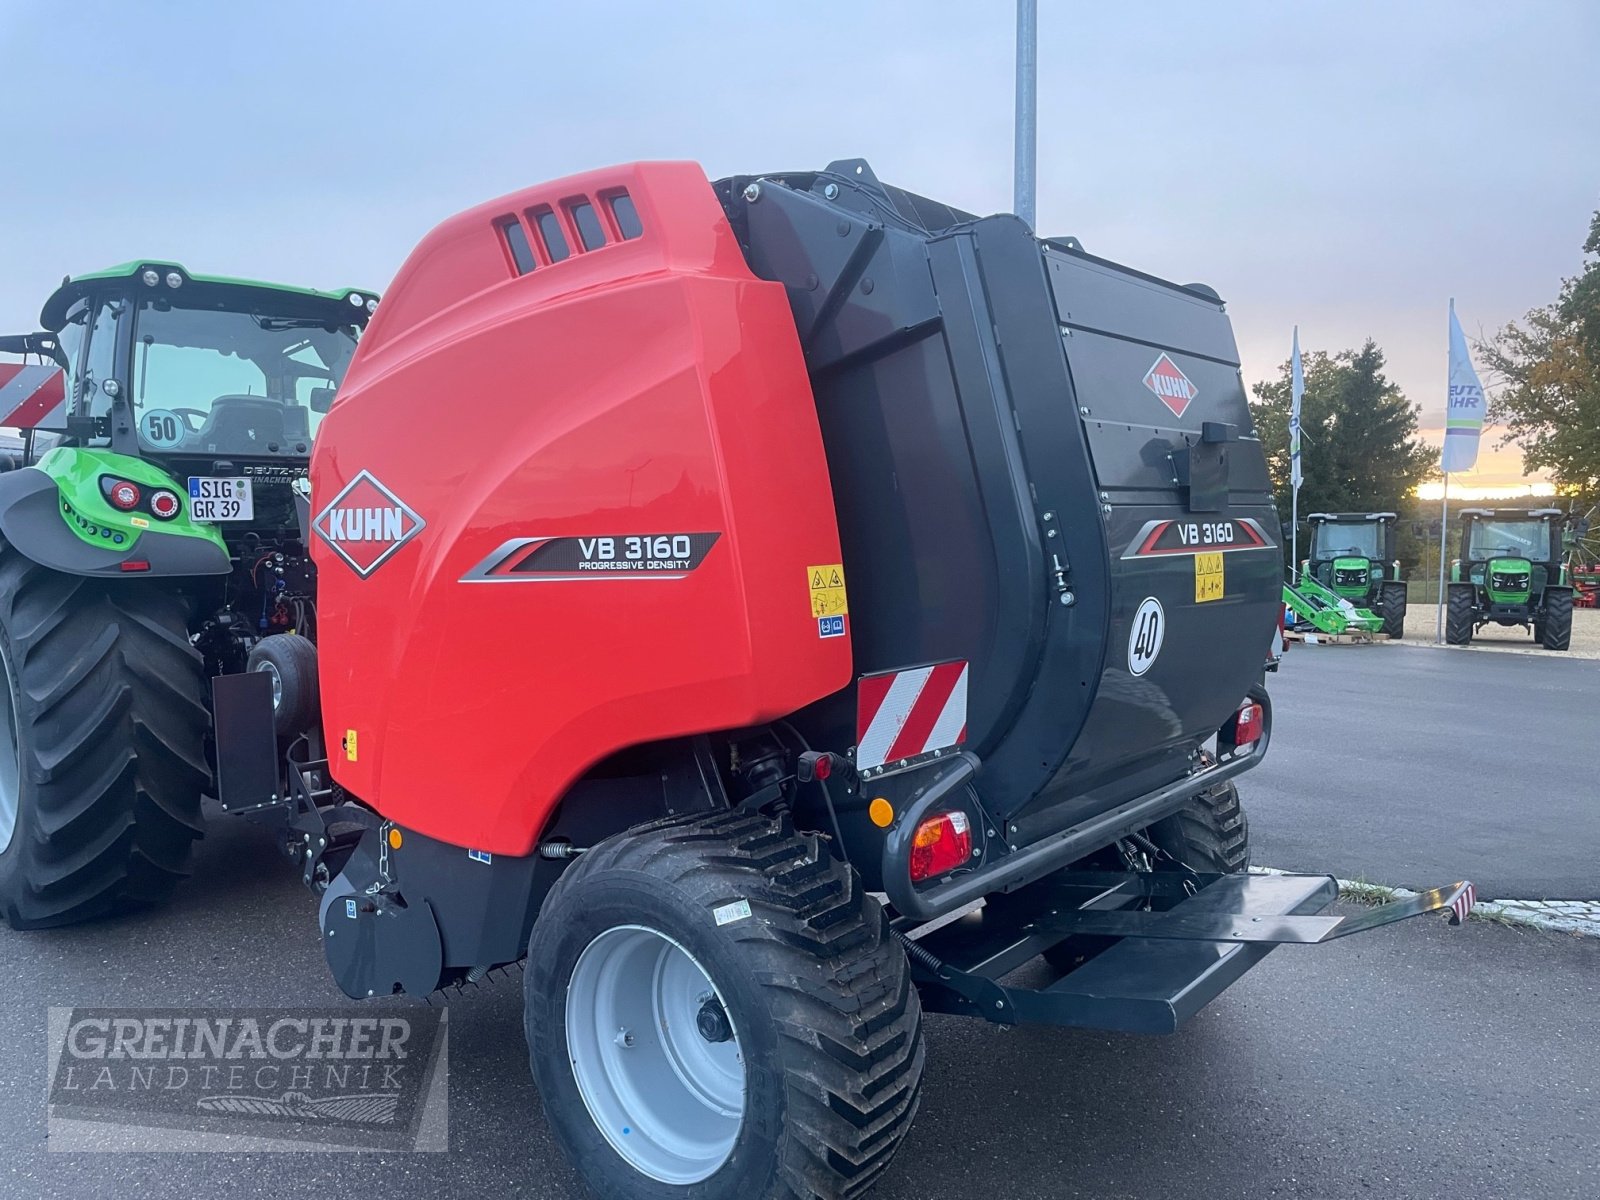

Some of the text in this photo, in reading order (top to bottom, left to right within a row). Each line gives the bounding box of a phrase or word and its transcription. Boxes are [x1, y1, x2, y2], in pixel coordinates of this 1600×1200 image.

[1151, 373, 1191, 400] KUHN
[149, 416, 176, 441] 50
[201, 481, 232, 498] SIG
[194, 501, 240, 518] GR 39
[330, 507, 402, 541] KUHN
[1178, 522, 1234, 545] VB 3160
[578, 535, 691, 560] VB 3160
[578, 560, 691, 570] PROGRESSIVE DENSITY
[1133, 610, 1159, 660] 40
